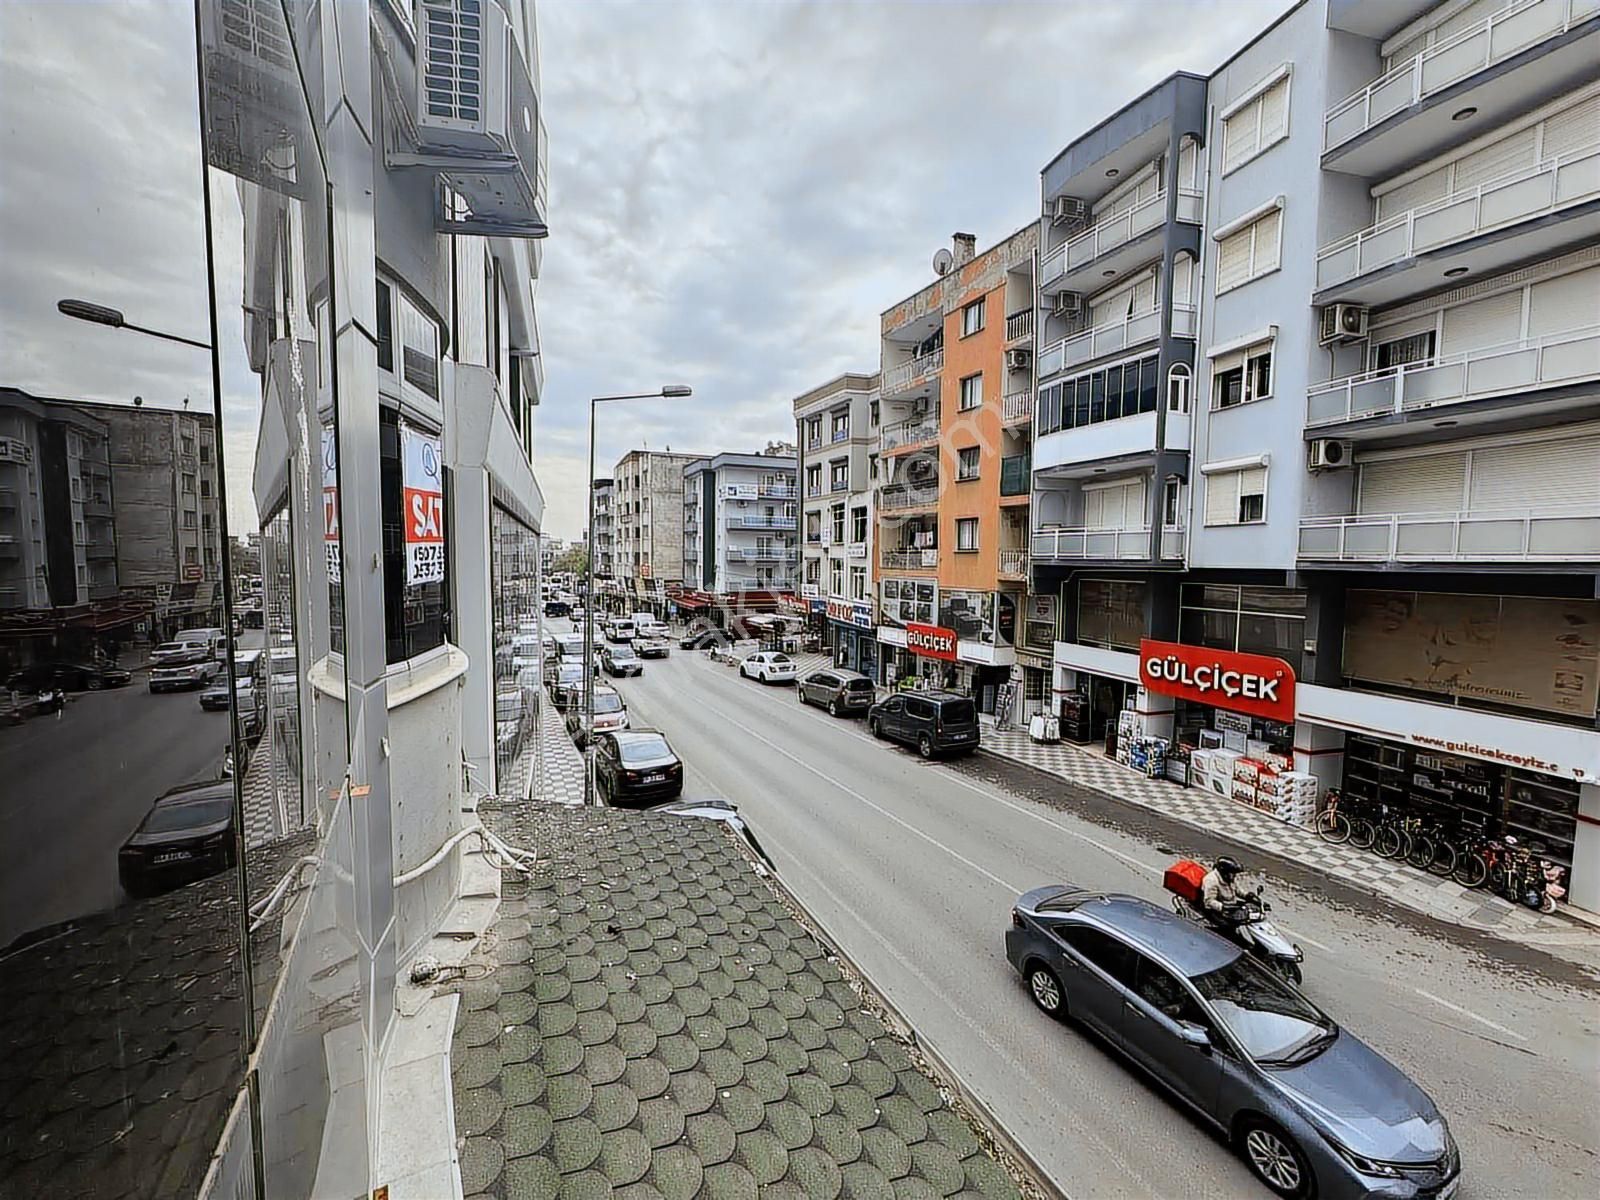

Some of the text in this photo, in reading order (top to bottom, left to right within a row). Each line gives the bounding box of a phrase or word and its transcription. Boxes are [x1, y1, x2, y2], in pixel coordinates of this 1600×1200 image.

[907, 630, 953, 652] GÜLÇİÇEK
[1146, 656, 1278, 702] GÜLÇİÇEK
[1411, 734, 1585, 777] www.gulcicekceyiz.cm
